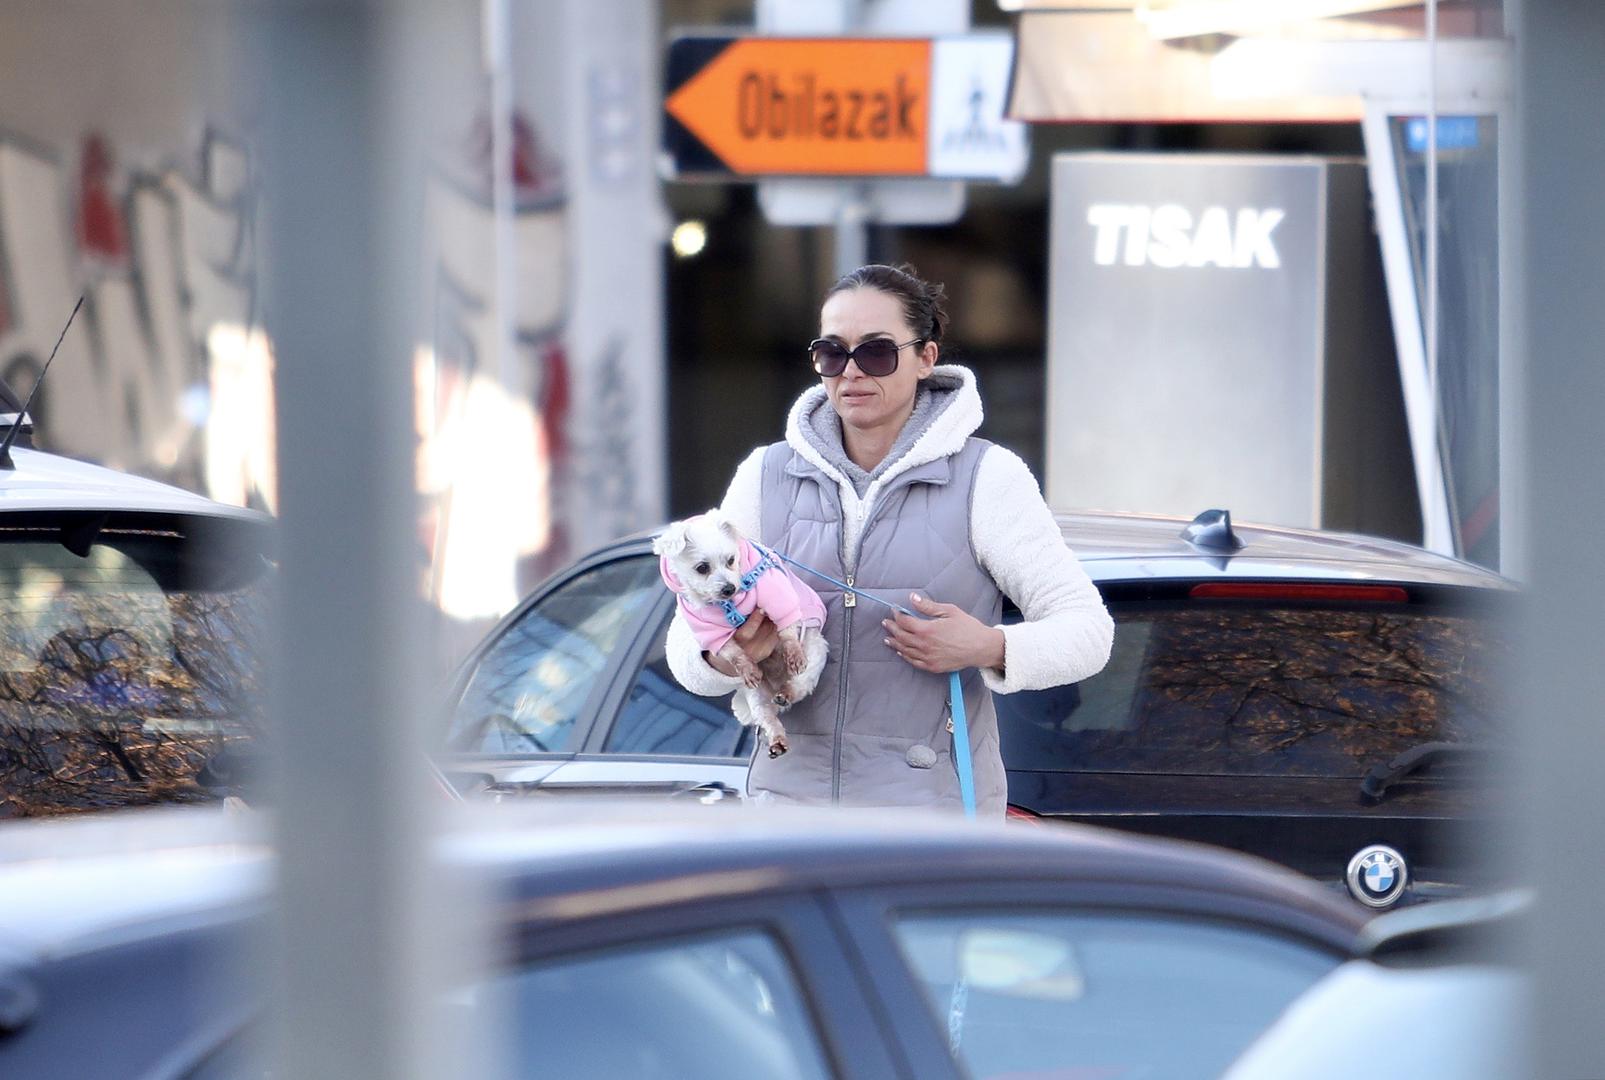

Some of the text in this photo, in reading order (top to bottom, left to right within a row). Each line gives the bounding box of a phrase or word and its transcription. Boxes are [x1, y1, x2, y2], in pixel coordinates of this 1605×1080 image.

[738, 70, 918, 140] Obilazak
[1088, 204, 1285, 269] TISAK
[1361, 852, 1399, 869] BMW
